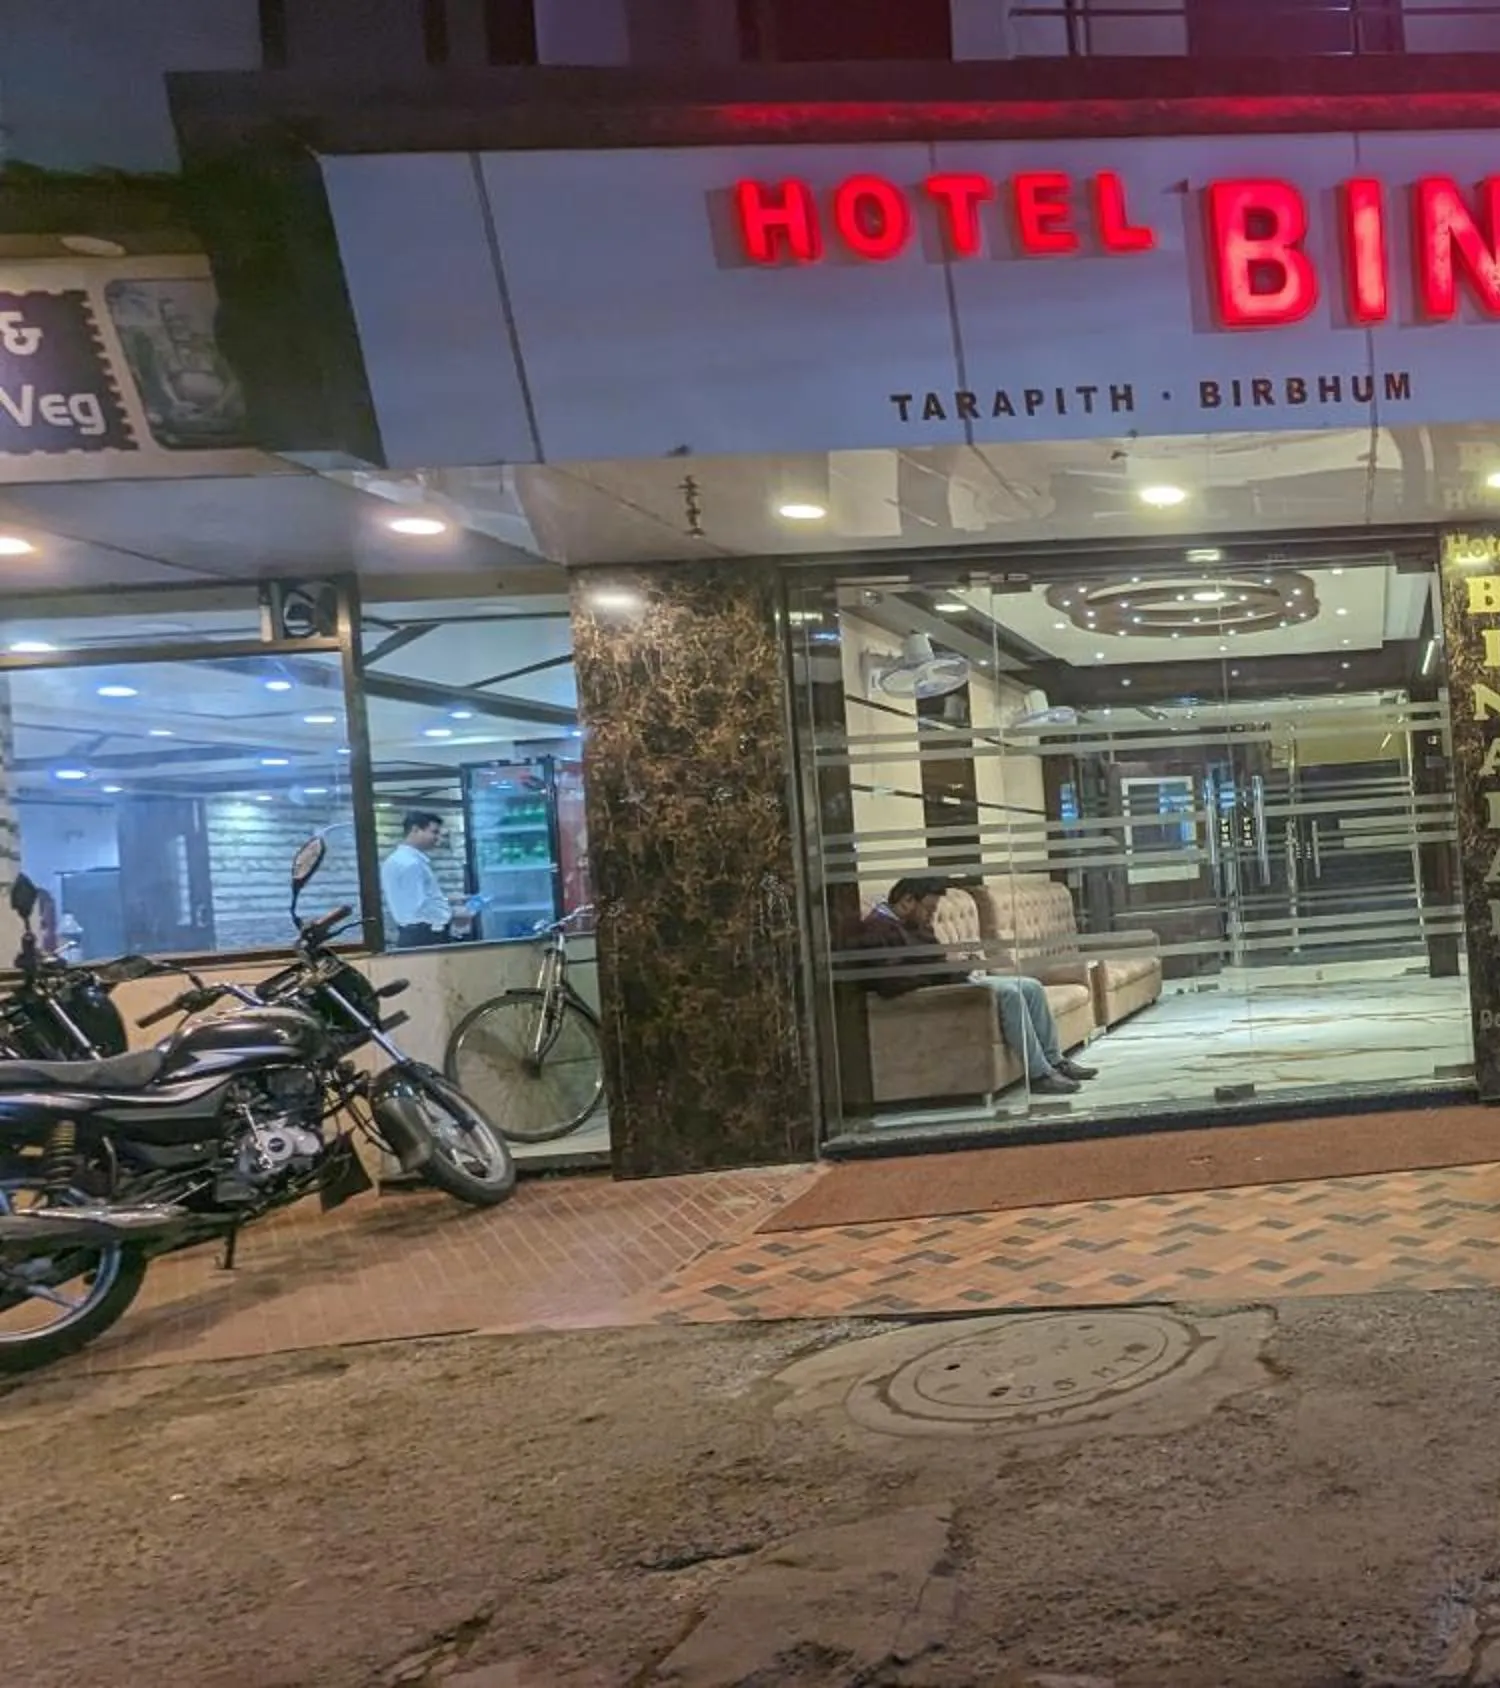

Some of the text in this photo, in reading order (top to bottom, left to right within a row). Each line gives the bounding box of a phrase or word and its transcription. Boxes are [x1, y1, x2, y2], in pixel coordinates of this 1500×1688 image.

[735, 171, 1155, 264] HOTEL
[891, 371, 1412, 423] TARAPITH BIRBHUM
